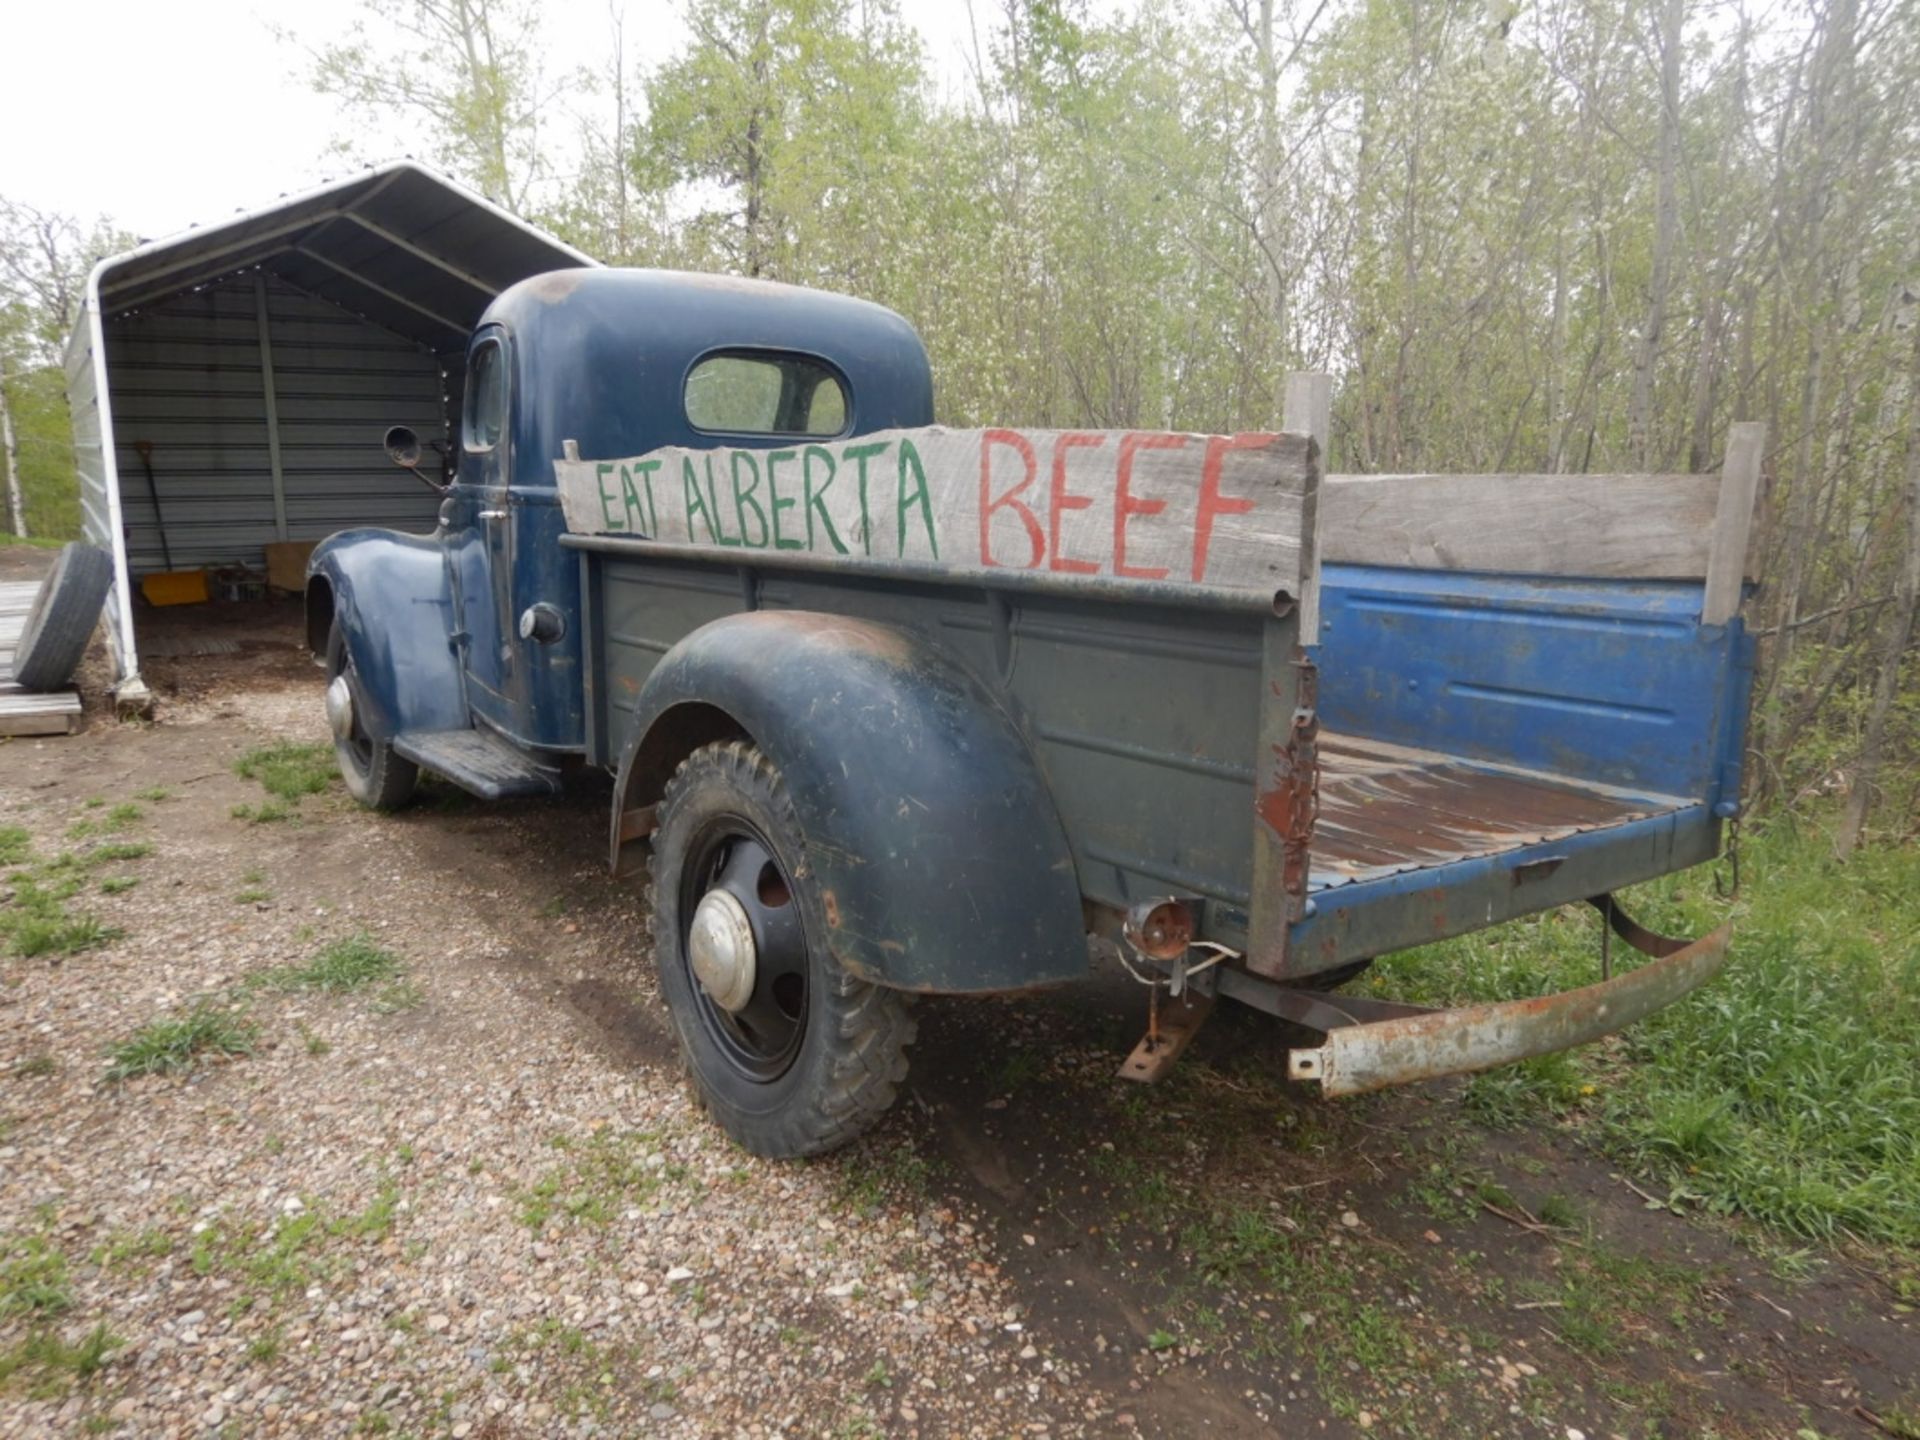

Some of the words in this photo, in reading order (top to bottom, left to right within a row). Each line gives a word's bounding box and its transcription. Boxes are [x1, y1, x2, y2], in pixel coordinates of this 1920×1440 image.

[596, 459, 662, 540] EAT
[682, 437, 938, 561] ALBERTA
[979, 428, 1283, 583] BEEF
